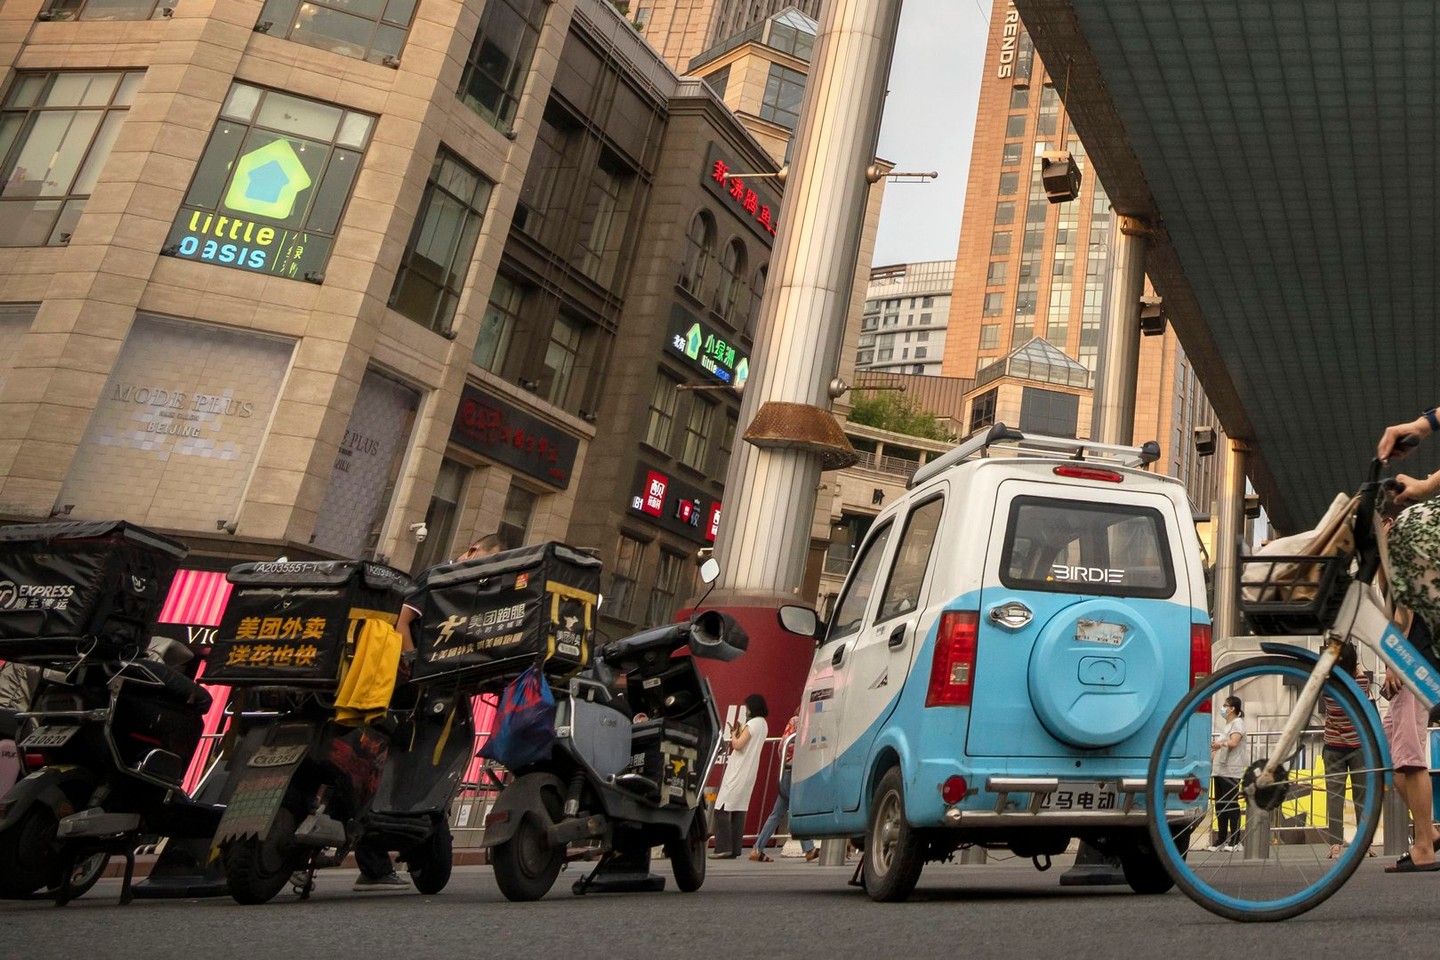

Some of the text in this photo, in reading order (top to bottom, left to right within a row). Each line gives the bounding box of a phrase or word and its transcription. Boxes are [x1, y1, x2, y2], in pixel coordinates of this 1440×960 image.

[188, 211, 275, 246] little
[179, 236, 266, 268] oasis
[111, 384, 255, 418] MODE PLUS
[147, 422, 201, 437] BEIJING
[1052, 564, 1125, 583] BIRDIE
[20, 585, 75, 597] EXPRESS
[234, 616, 328, 640] 美团外卖
[468, 603, 525, 629] 美团跑腿
